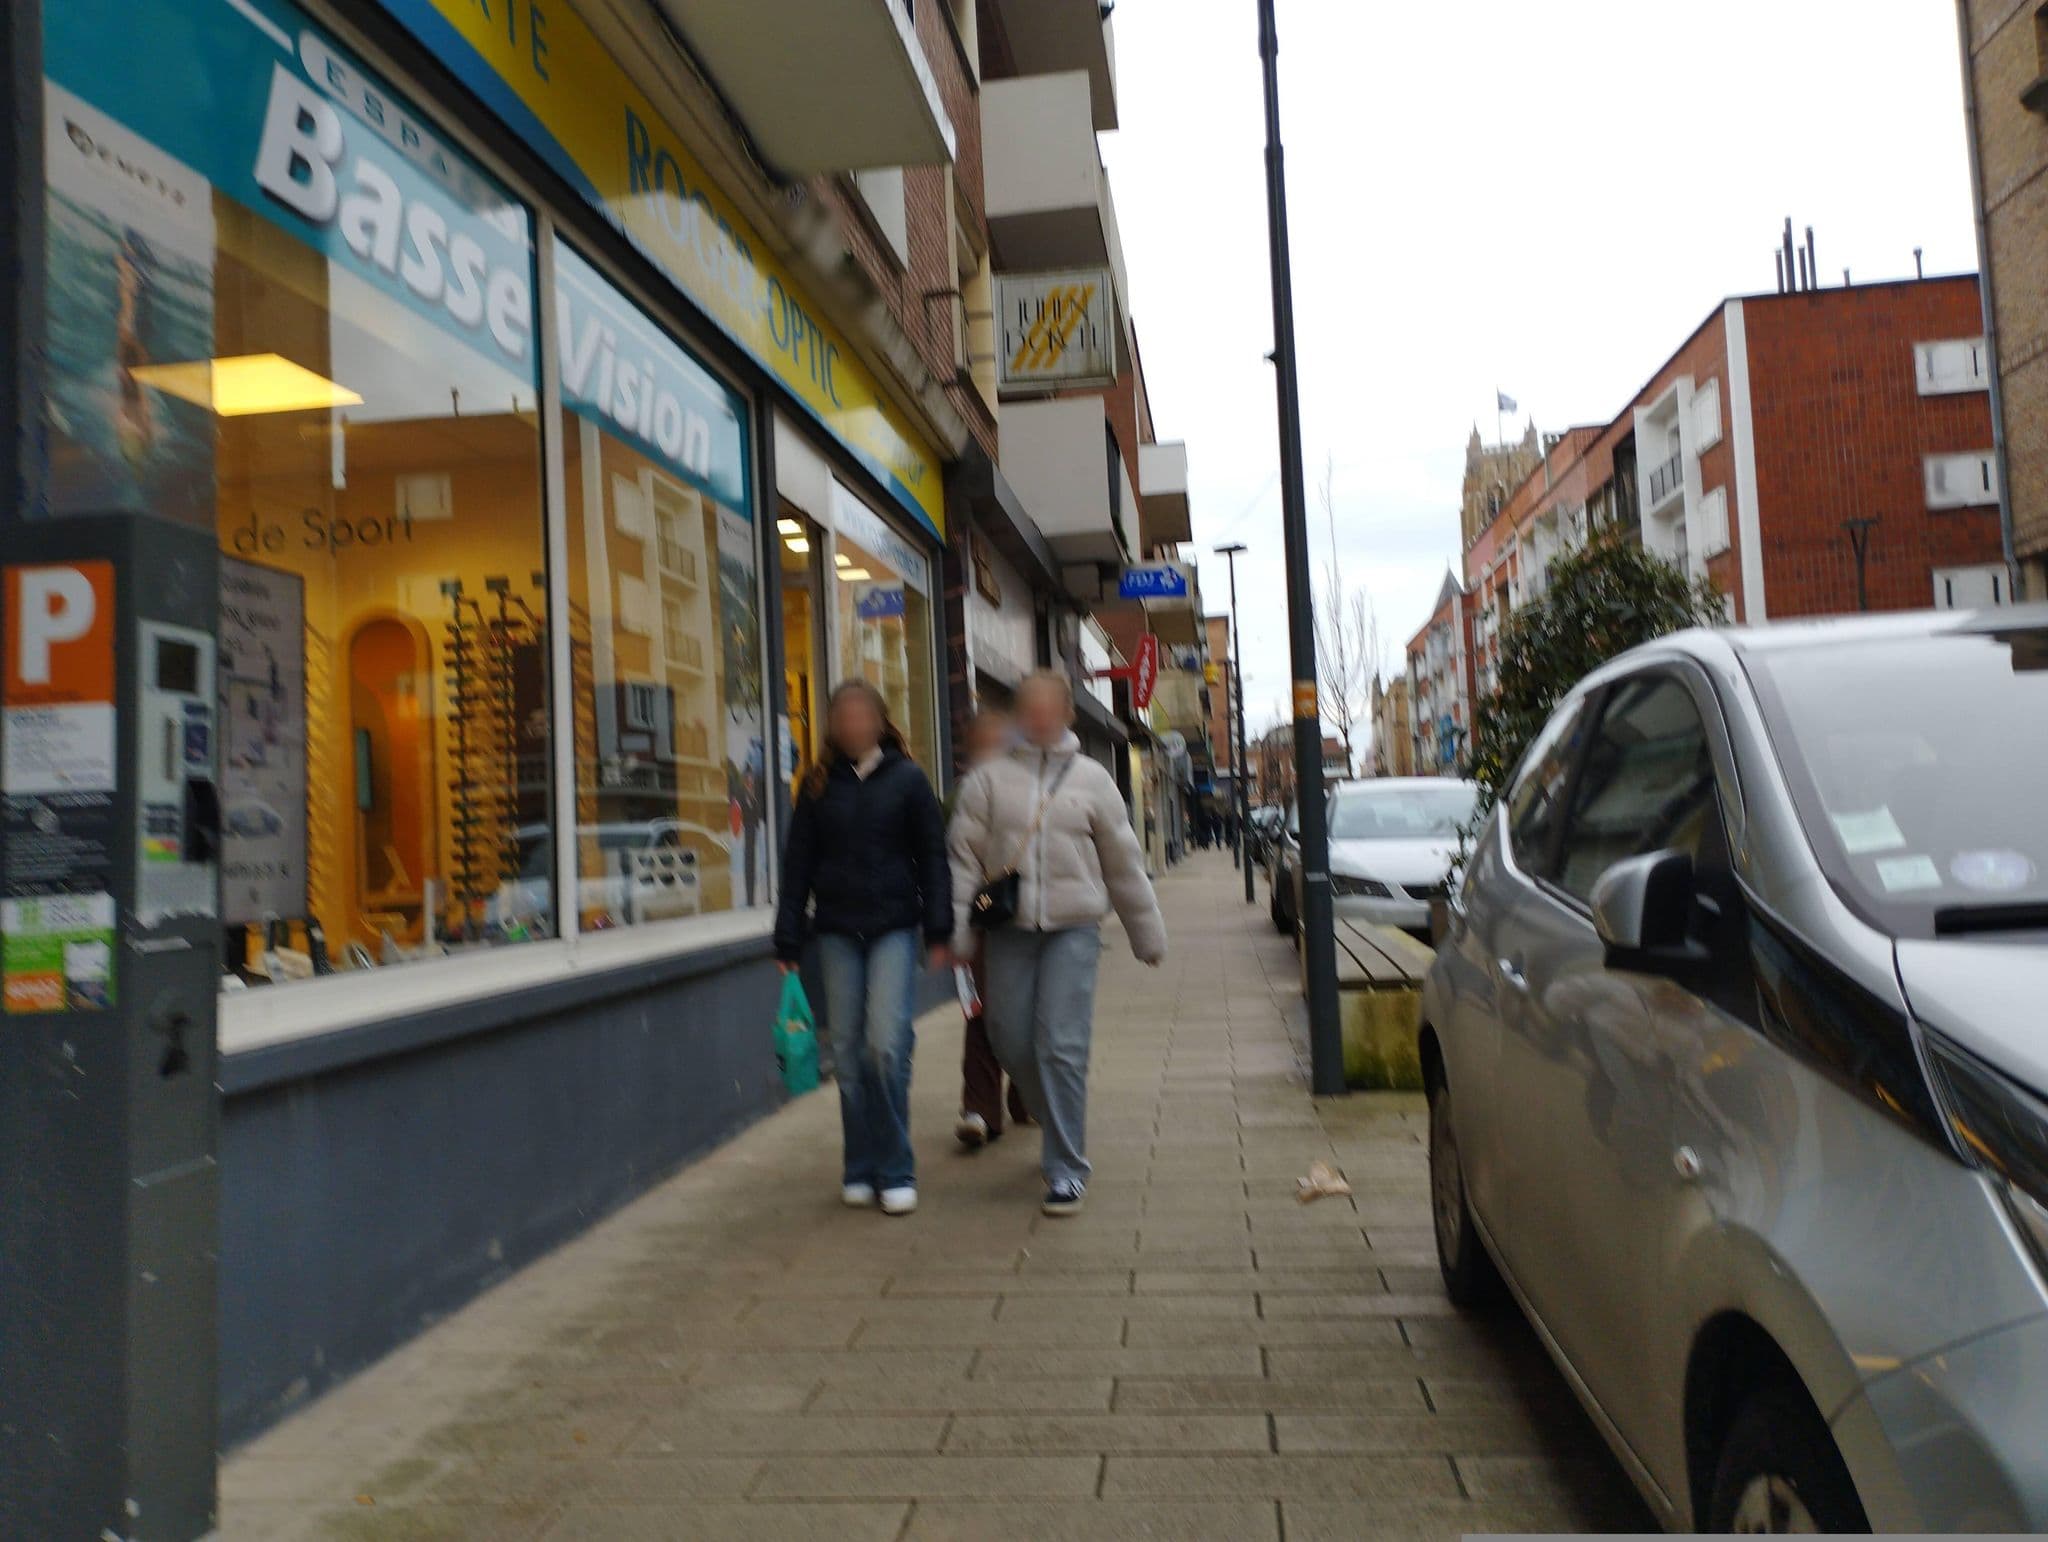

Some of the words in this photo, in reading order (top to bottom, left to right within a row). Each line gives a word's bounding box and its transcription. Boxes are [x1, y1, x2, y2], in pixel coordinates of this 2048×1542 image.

[254, 60, 530, 364] Basse
[553, 287, 711, 482] Vision
[767, 275, 842, 409] OPTIC
[233, 512, 286, 556] de
[303, 507, 412, 556] Sport
[19, 567, 96, 684] P
